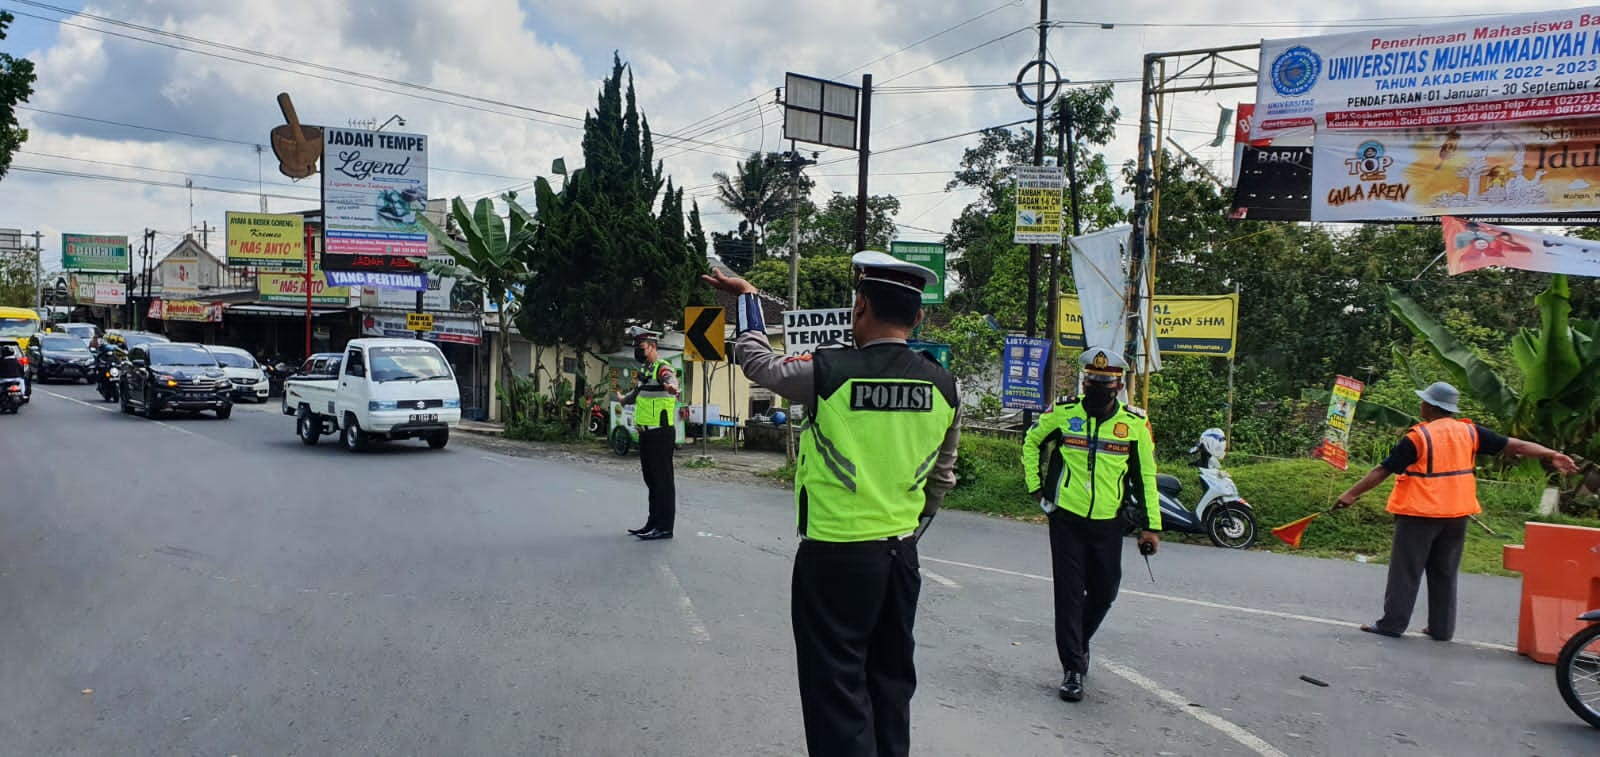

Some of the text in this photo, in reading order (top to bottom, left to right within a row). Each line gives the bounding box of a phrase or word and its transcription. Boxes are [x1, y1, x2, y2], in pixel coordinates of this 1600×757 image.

[1371, 32, 1466, 50] Penerimaan
[1473, 20, 1573, 40] Mahasiswa
[1328, 50, 1428, 81] UNIVERSITAS
[1432, 30, 1587, 71] MUHAMMADIYAH
[1376, 77, 1416, 91] TAHUN
[1422, 69, 1499, 87] AKADEMIK
[1444, 87, 1488, 101] Januari
[1503, 83, 1517, 96] 30
[1522, 78, 1589, 95] September
[1554, 94, 1594, 106] (0272)
[328, 130, 424, 151] JADAH TEMPE
[334, 151, 411, 180] Legend
[1345, 156, 1394, 176] TOP
[1328, 183, 1410, 206] GULA AREN
[240, 241, 262, 254] MAS
[264, 242, 291, 256] ANTO
[331, 271, 422, 288] YANG PERTAMA
[787, 311, 852, 328] JADAH
[1196, 316, 1225, 326] SHM
[787, 328, 854, 345] TEMPE
[854, 384, 932, 409] POLISI
